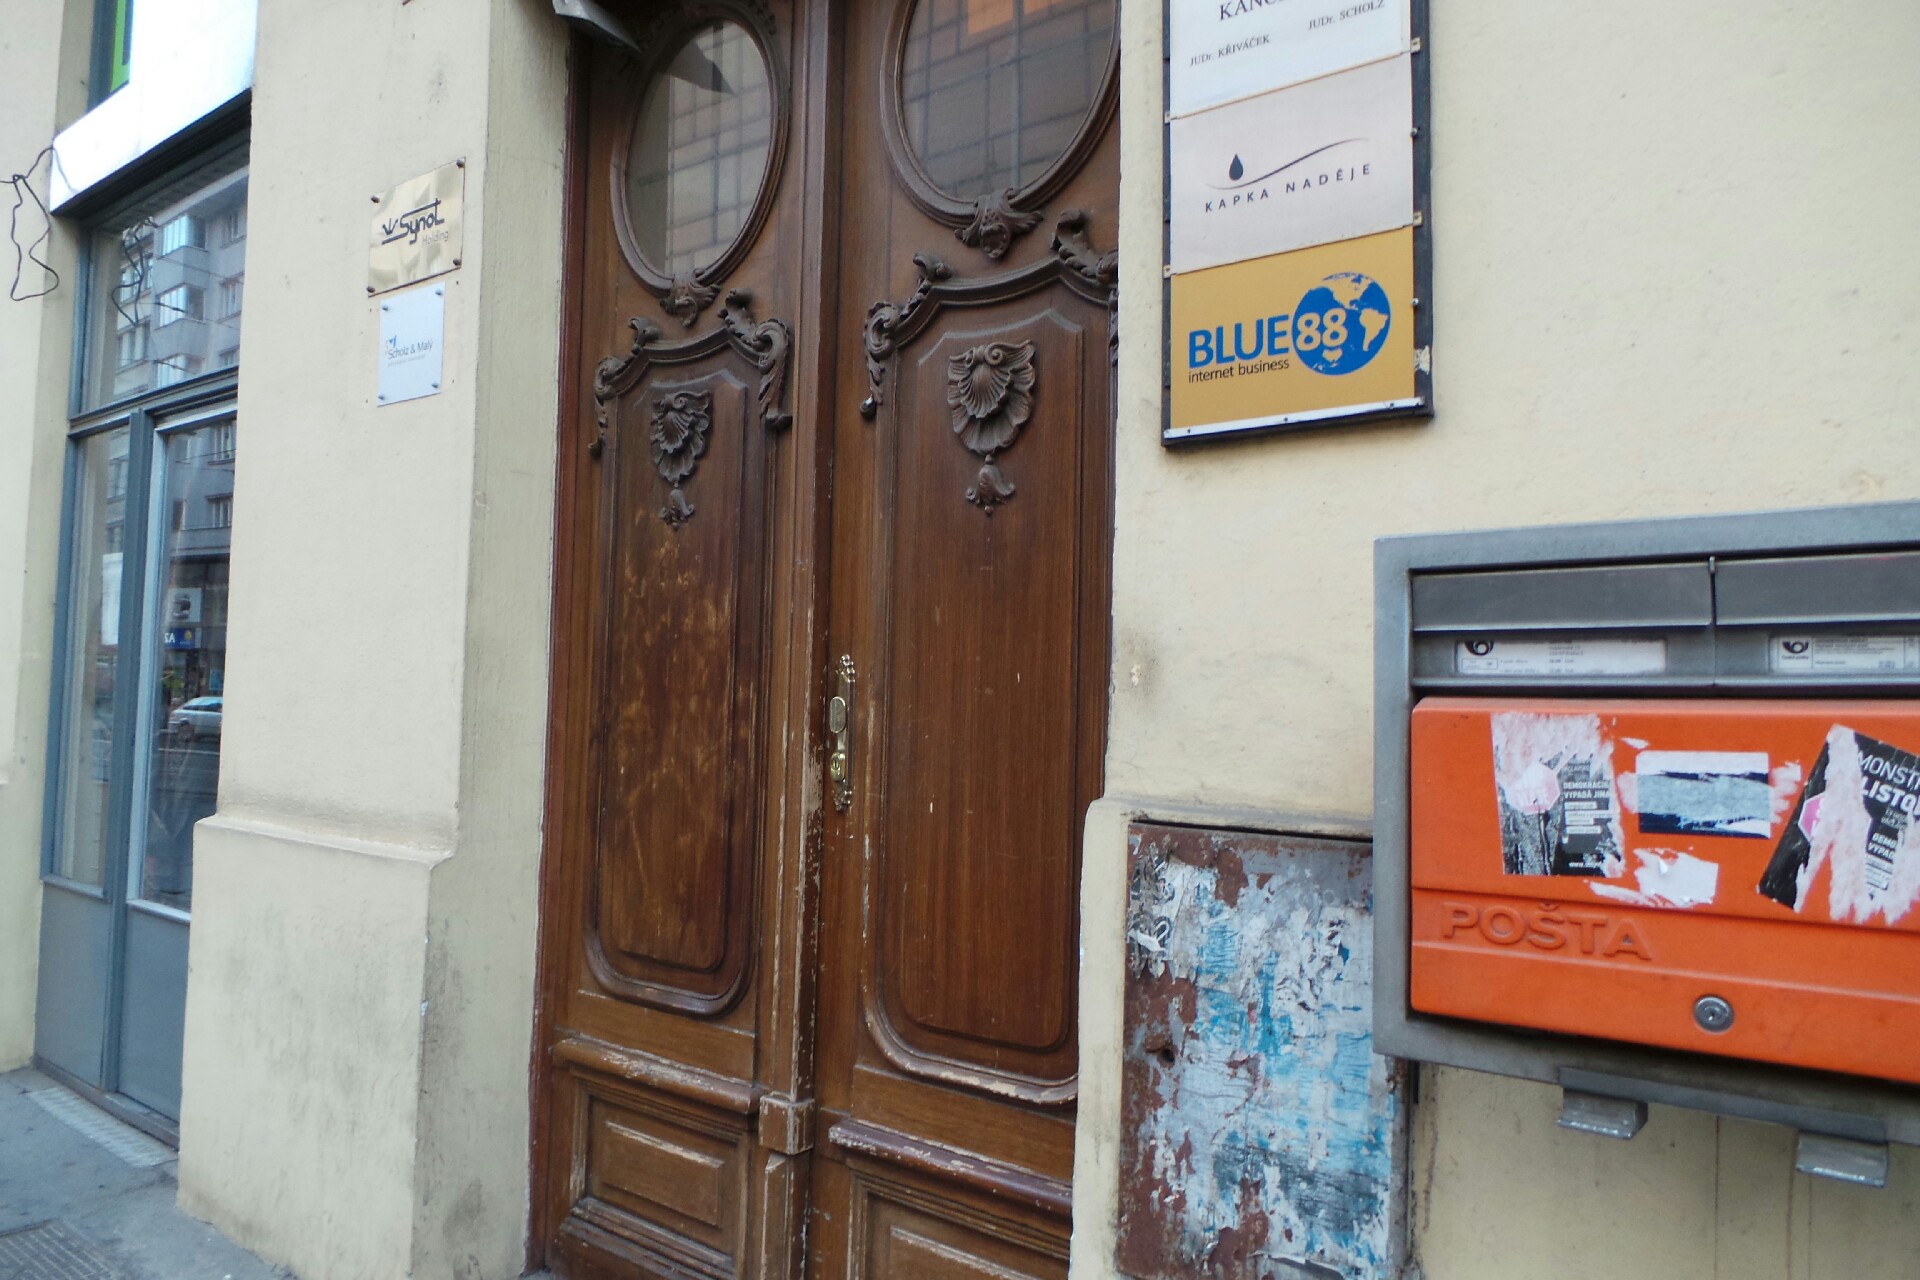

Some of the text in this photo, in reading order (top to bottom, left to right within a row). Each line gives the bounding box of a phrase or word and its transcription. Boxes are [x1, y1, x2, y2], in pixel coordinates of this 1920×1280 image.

[1219, 0, 1279, 21] KAN
[1309, 0, 1385, 30] JUDr. SCHOLZ
[1218, 34, 1270, 58] KŘIVÁČEK
[1205, 164, 1371, 213] KAPKA NADĚJE
[1188, 358, 1290, 383] internet business
[1857, 749, 1920, 790] MONST
[1442, 899, 1652, 961] POŠTA
